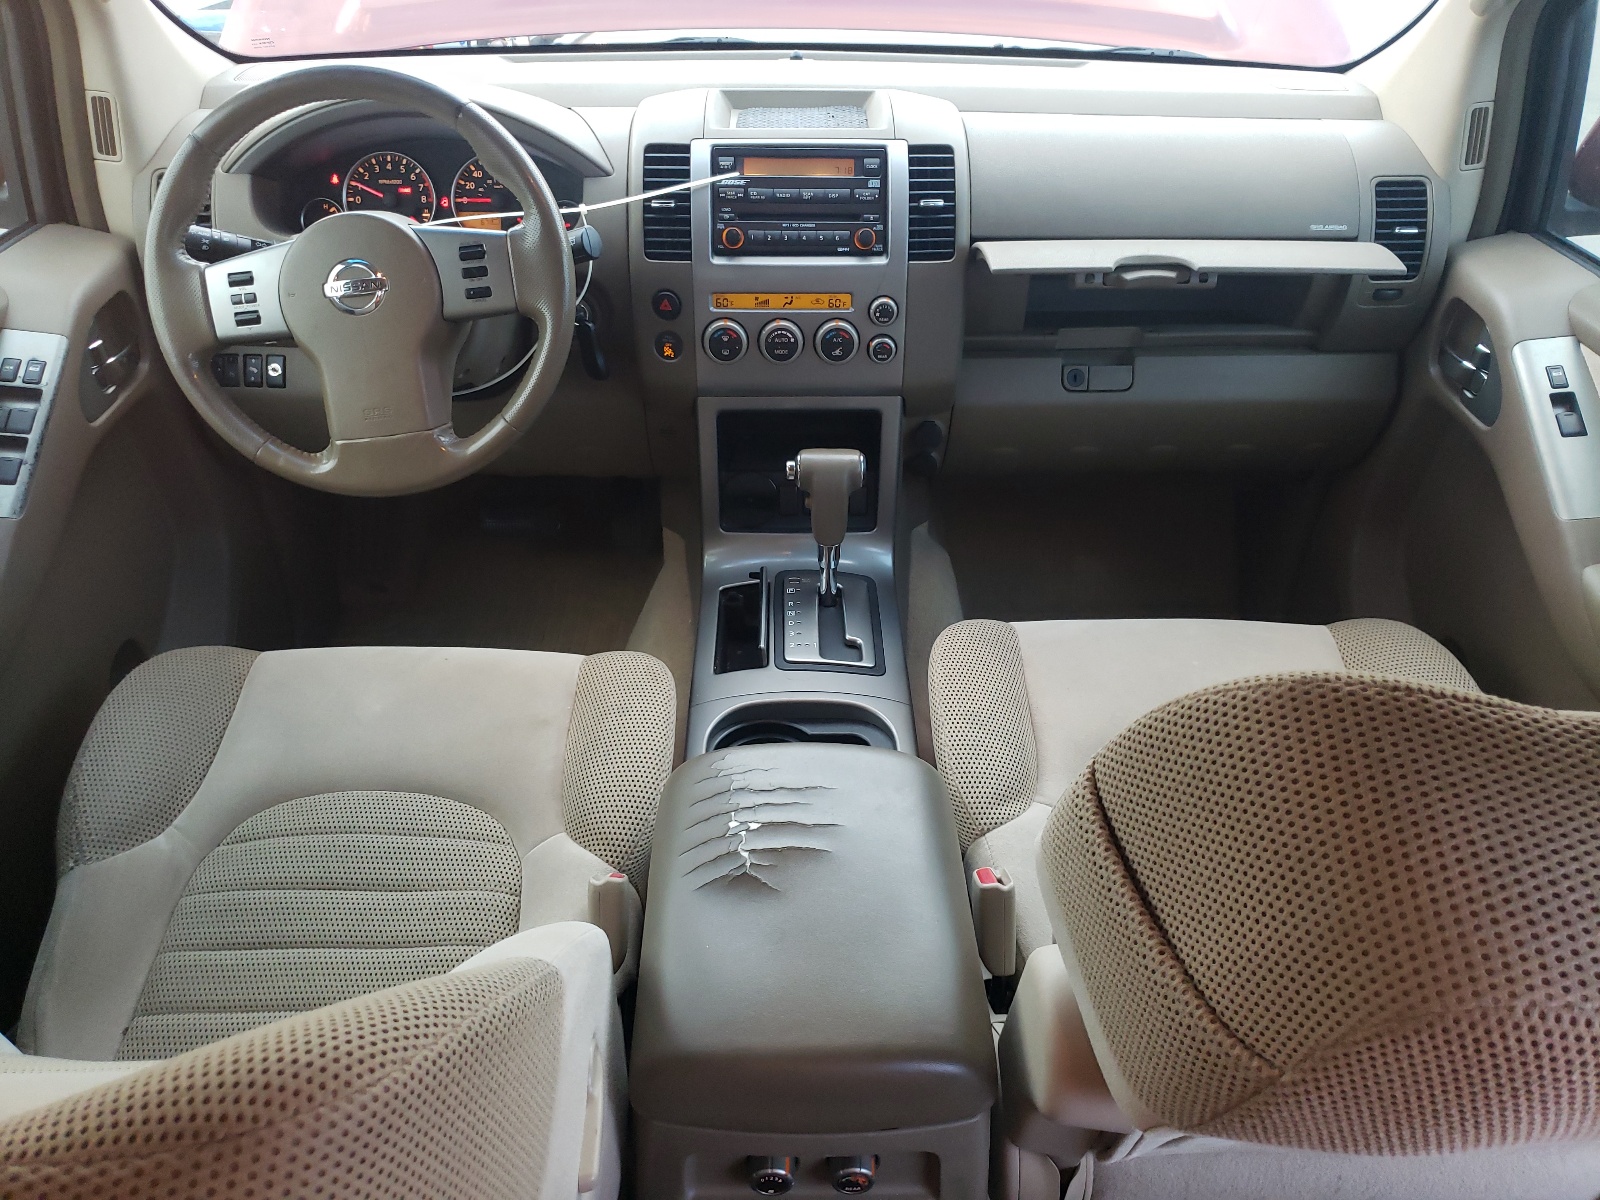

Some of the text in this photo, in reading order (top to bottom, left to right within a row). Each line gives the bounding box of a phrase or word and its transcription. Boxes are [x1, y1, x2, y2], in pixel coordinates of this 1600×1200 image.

[472, 170, 483, 178] 40
[364, 172, 370, 180] 2
[374, 165, 380, 173] 3
[400, 165, 406, 173] 5
[410, 173, 416, 181] 6
[421, 195, 427, 203] 8
[465, 181, 476, 189] 20
[355, 196, 362, 204] 0
[330, 281, 381, 294] NISSAN
